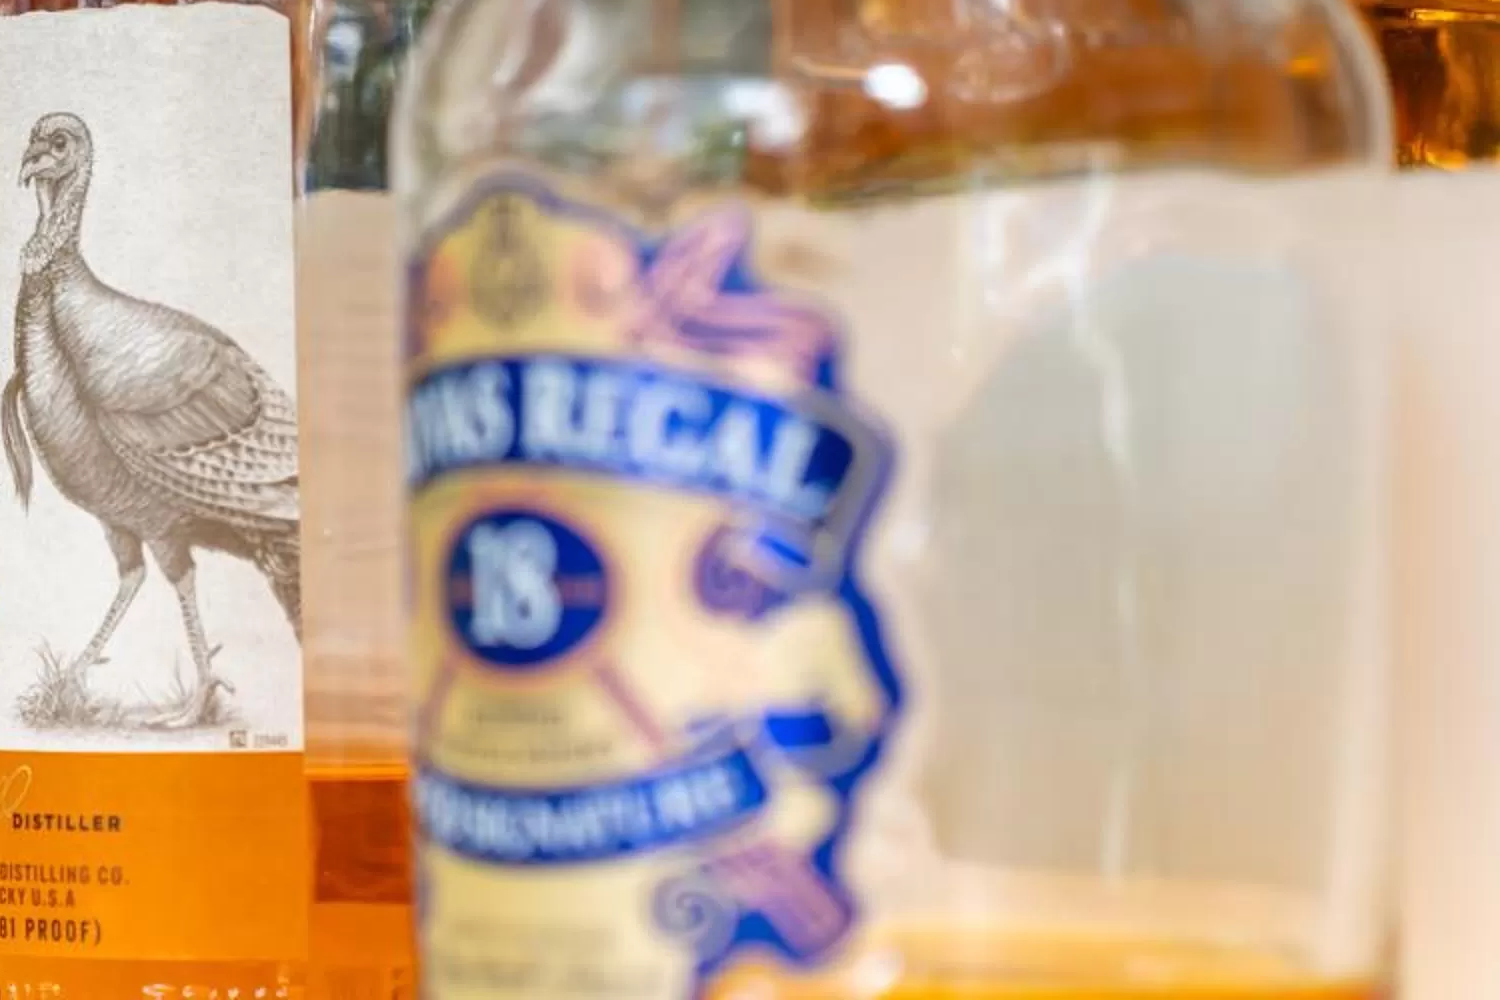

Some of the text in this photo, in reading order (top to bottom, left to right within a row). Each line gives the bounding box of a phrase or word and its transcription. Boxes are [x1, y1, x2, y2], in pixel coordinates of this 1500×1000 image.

[470, 519, 562, 649] 18
[12, 812, 121, 832] DISTILLER
[0, 861, 91, 884] DISTILLING
[97, 865, 130, 886] CO.
[25, 917, 102, 945] PROOF)
